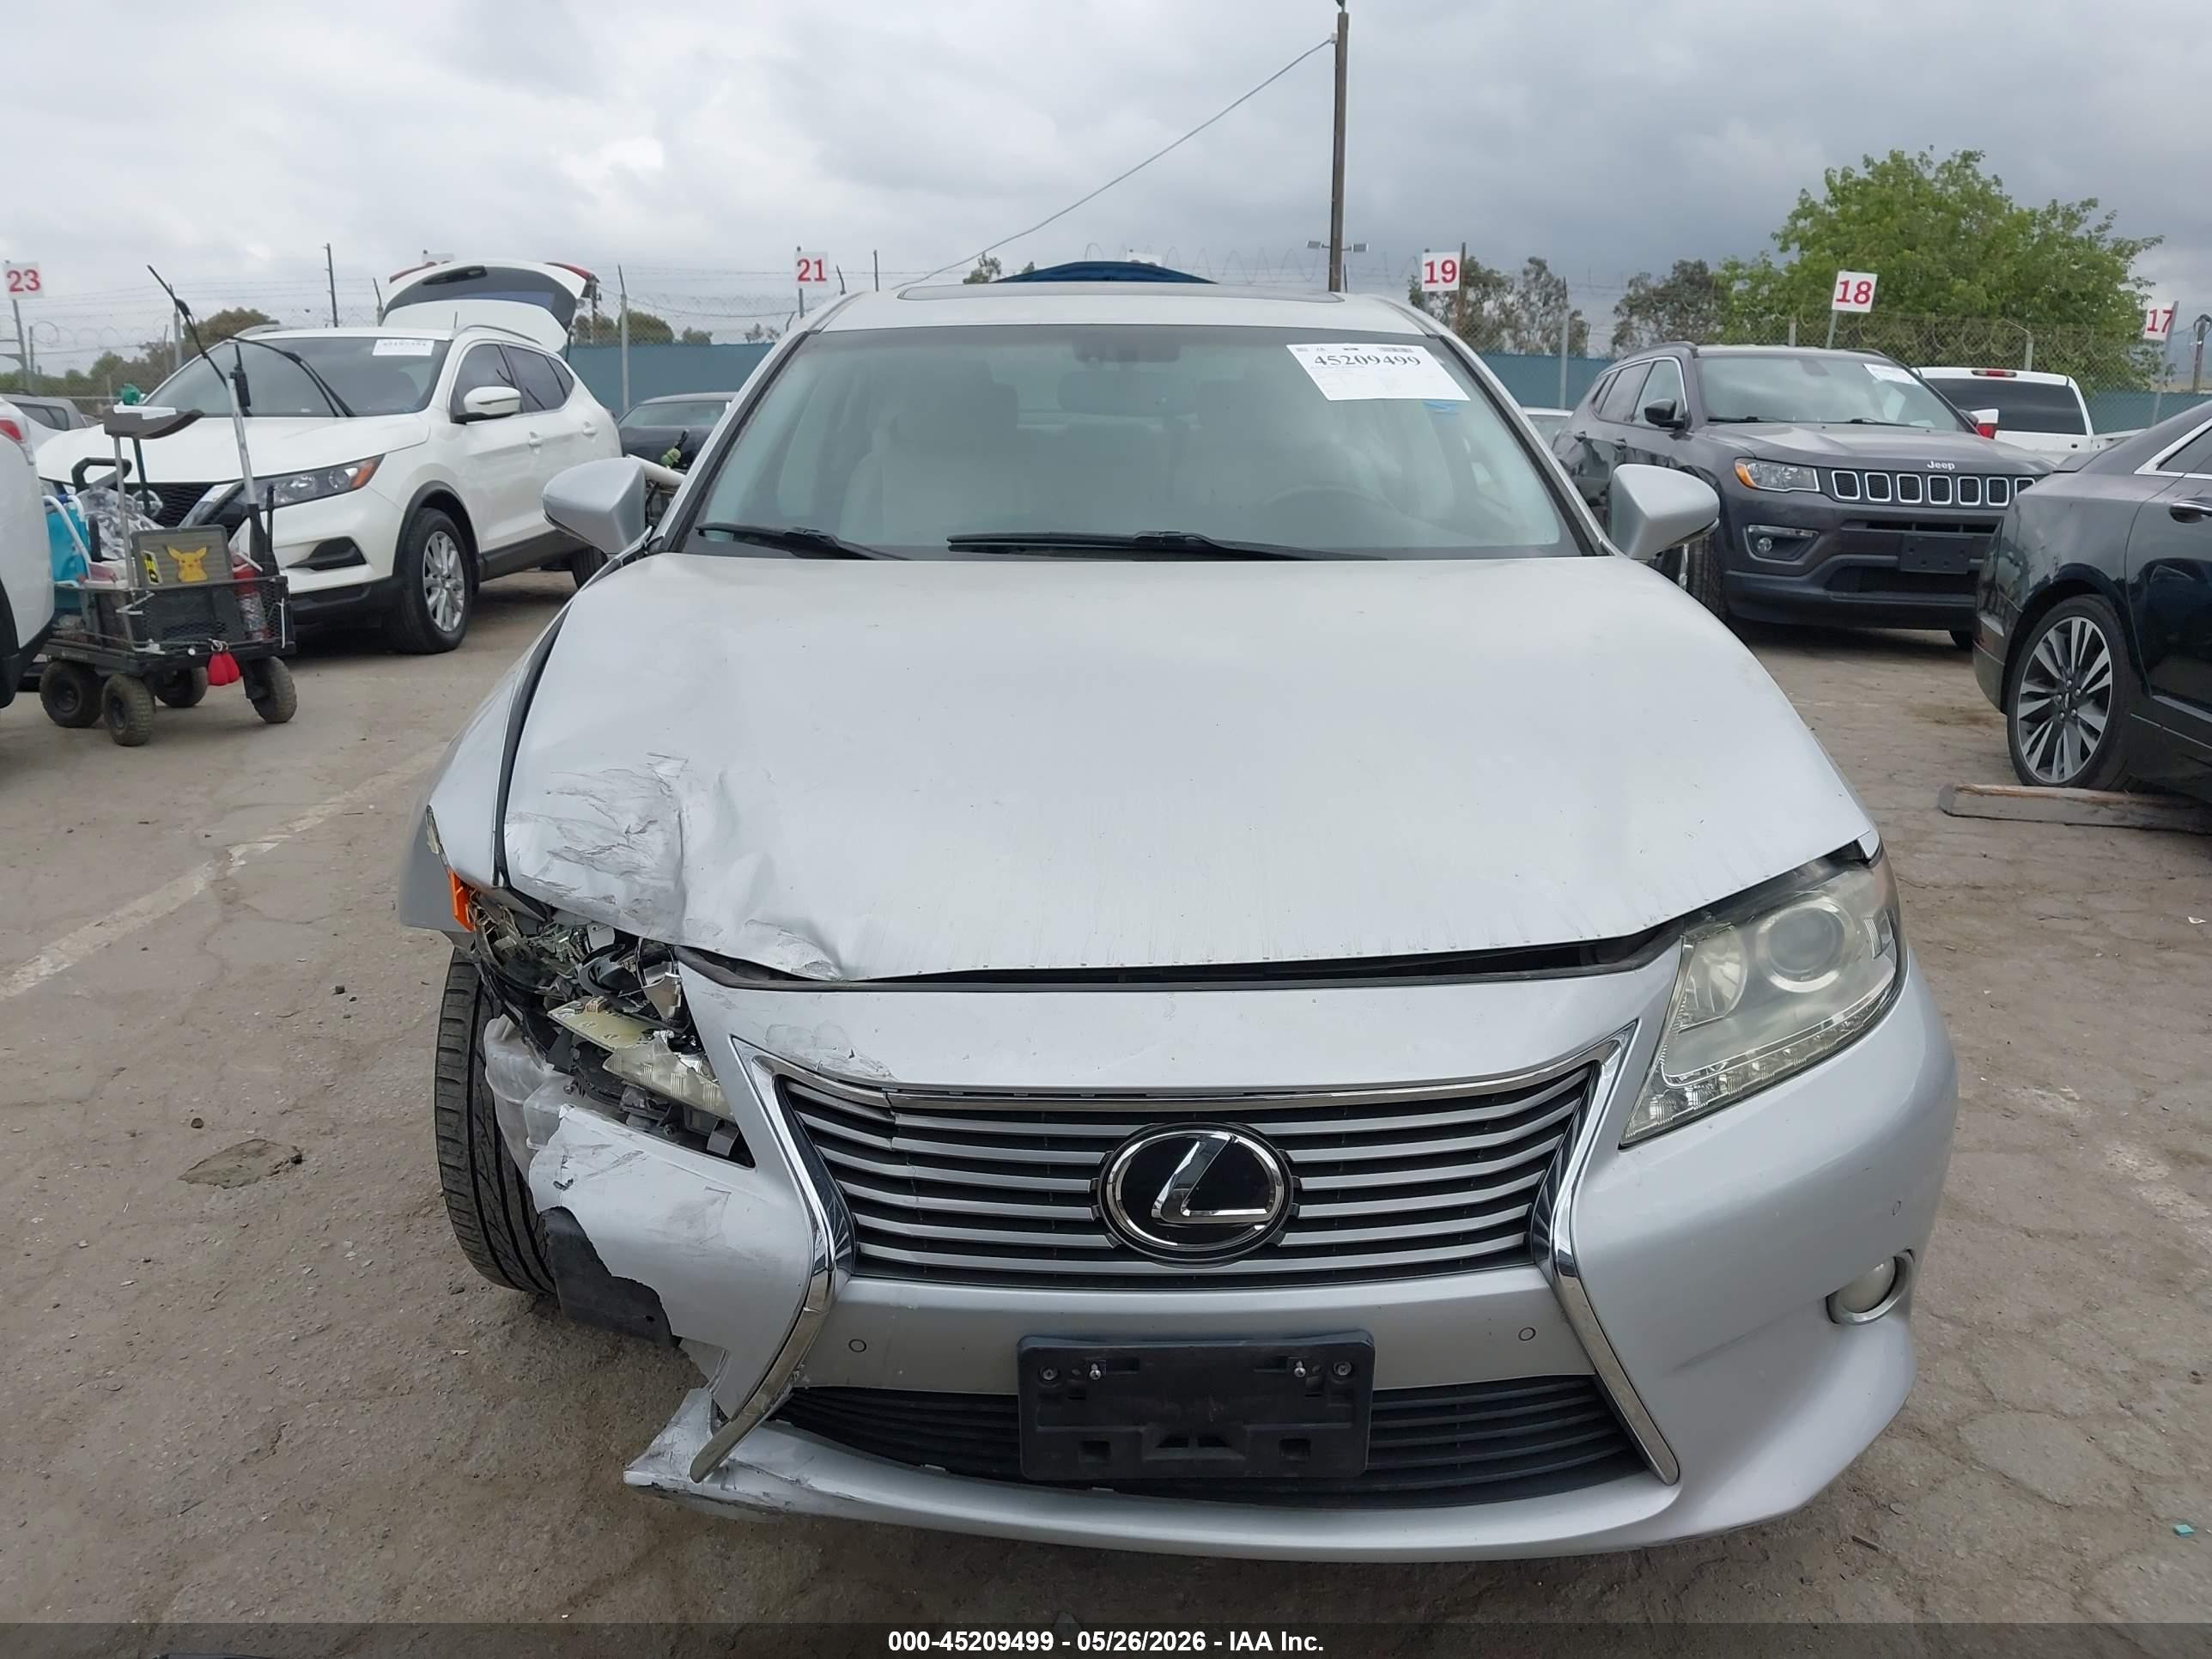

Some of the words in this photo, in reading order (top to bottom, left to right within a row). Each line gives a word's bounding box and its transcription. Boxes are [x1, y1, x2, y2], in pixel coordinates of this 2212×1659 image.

[6, 269, 40, 292] 23
[797, 258, 827, 282] 21
[1424, 259, 1457, 283] 19
[1835, 279, 1872, 304] 18
[2147, 309, 2173, 332] 17
[1314, 354, 1421, 366] 45209499
[1926, 460, 1955, 471] Jeep
